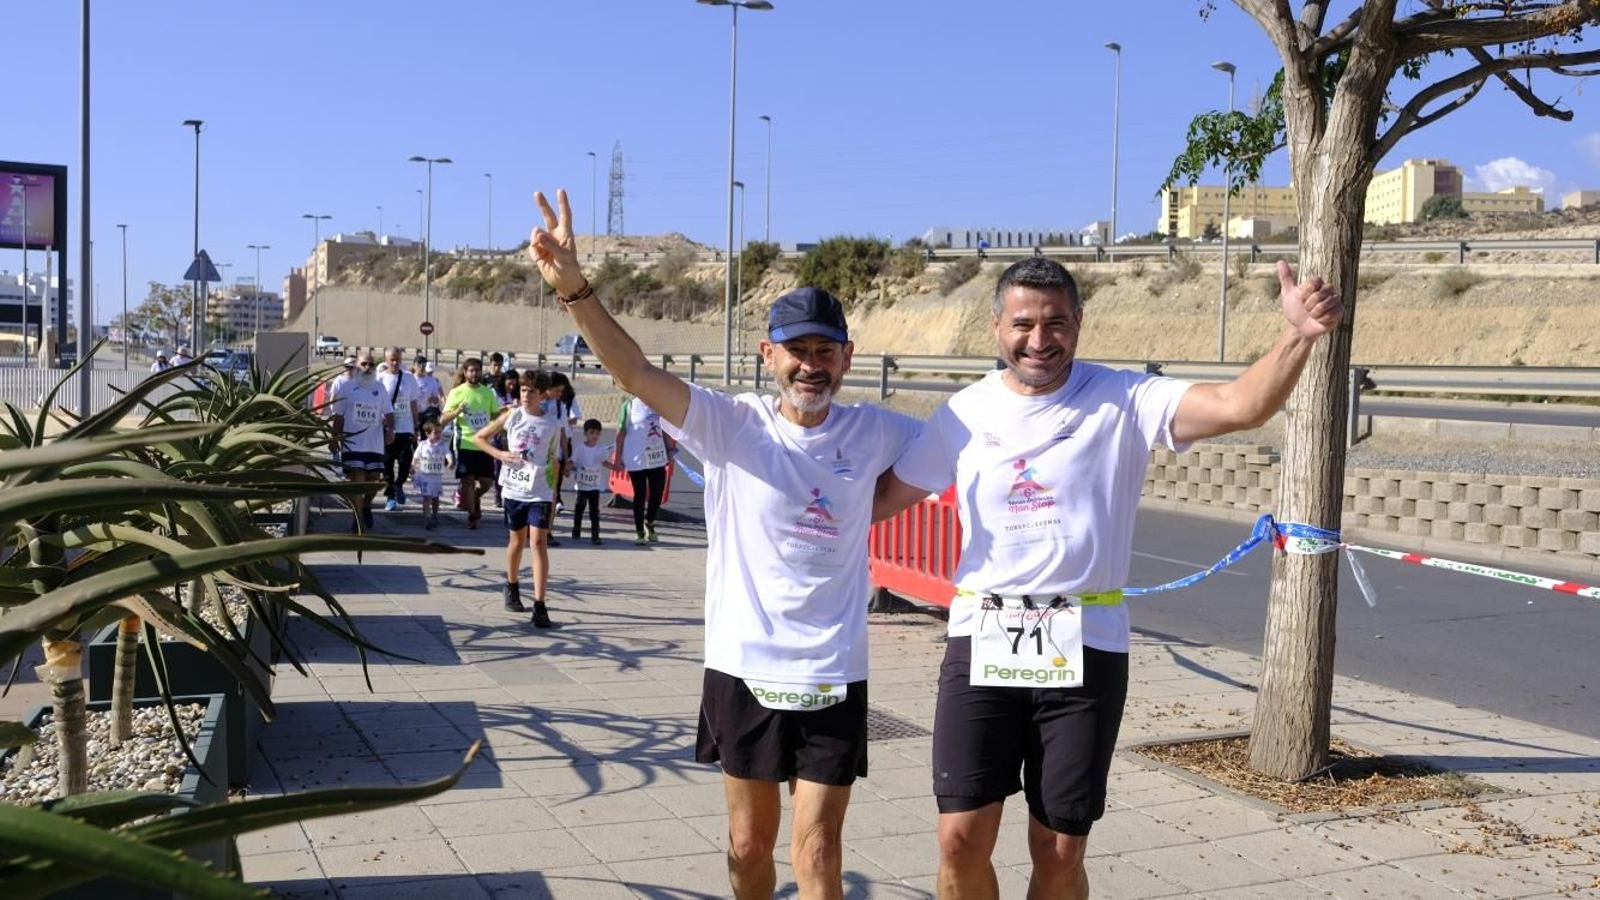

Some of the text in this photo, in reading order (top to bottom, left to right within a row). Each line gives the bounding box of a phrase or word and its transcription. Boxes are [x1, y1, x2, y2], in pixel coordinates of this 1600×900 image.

[356, 410, 377, 419] 1614
[506, 467, 530, 482] 1554
[1007, 627, 1043, 655] 71
[984, 663, 1076, 684] Peregrin
[752, 686, 840, 708] Peregrin
